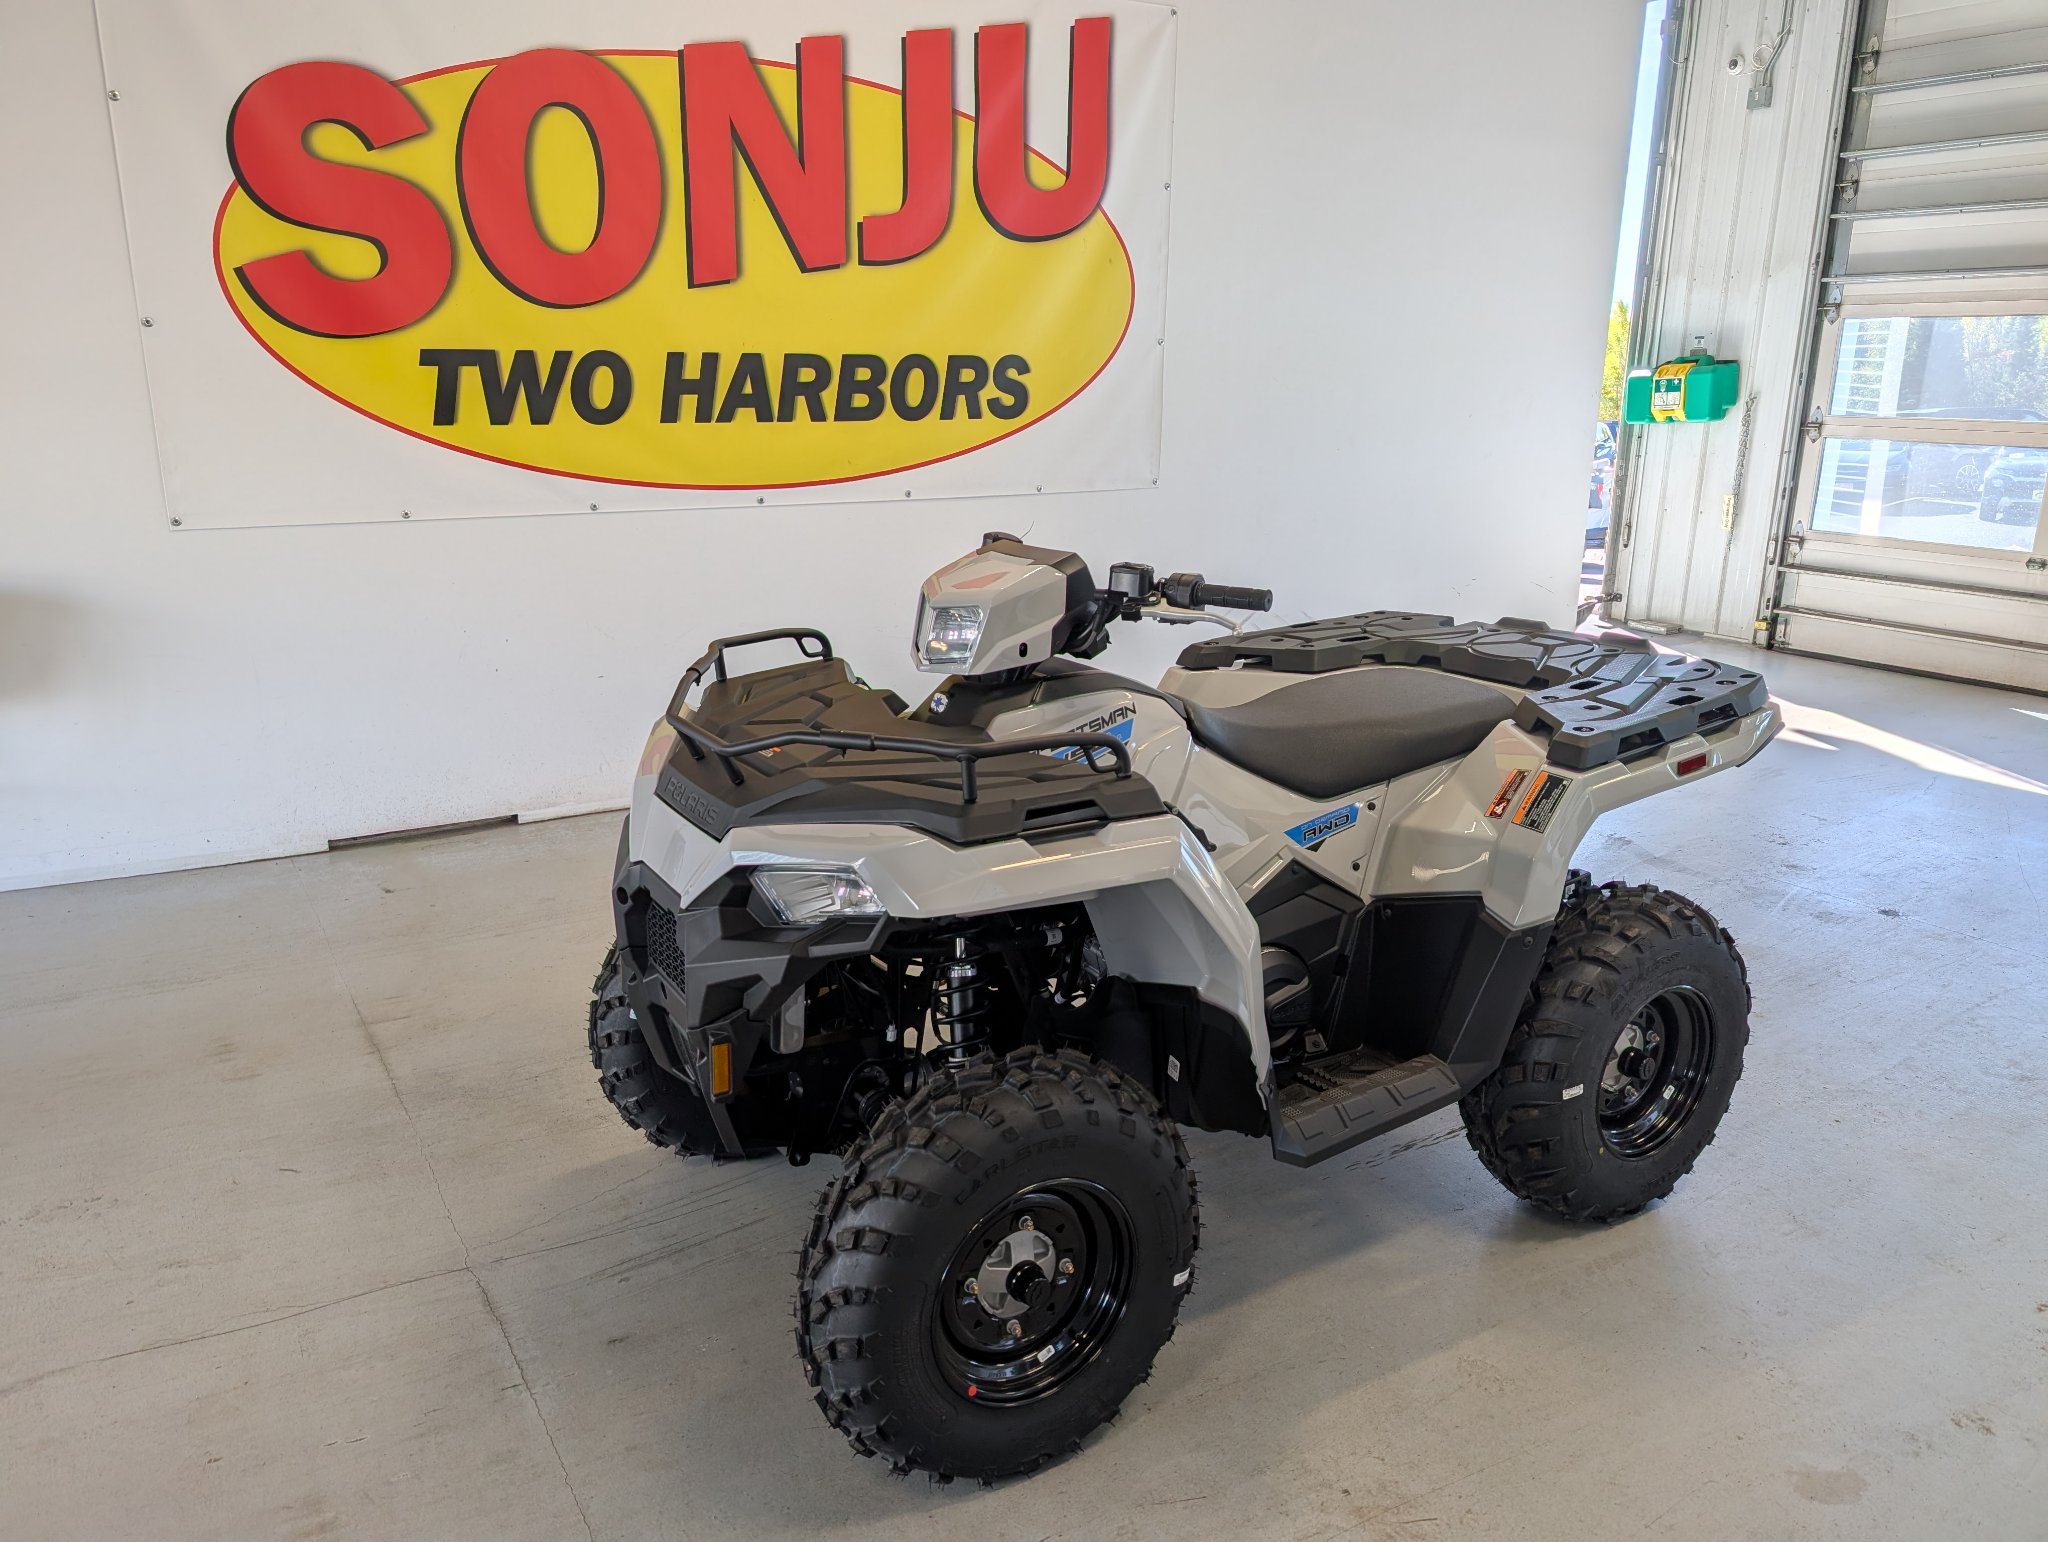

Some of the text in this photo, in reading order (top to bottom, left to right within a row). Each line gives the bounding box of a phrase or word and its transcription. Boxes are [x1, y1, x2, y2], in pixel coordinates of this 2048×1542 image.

[226, 17, 1111, 339] SONJU
[419, 349, 1031, 425] TWO HARBORS
[664, 776, 718, 825] POLARIS
[1302, 813, 1351, 843] AWD
